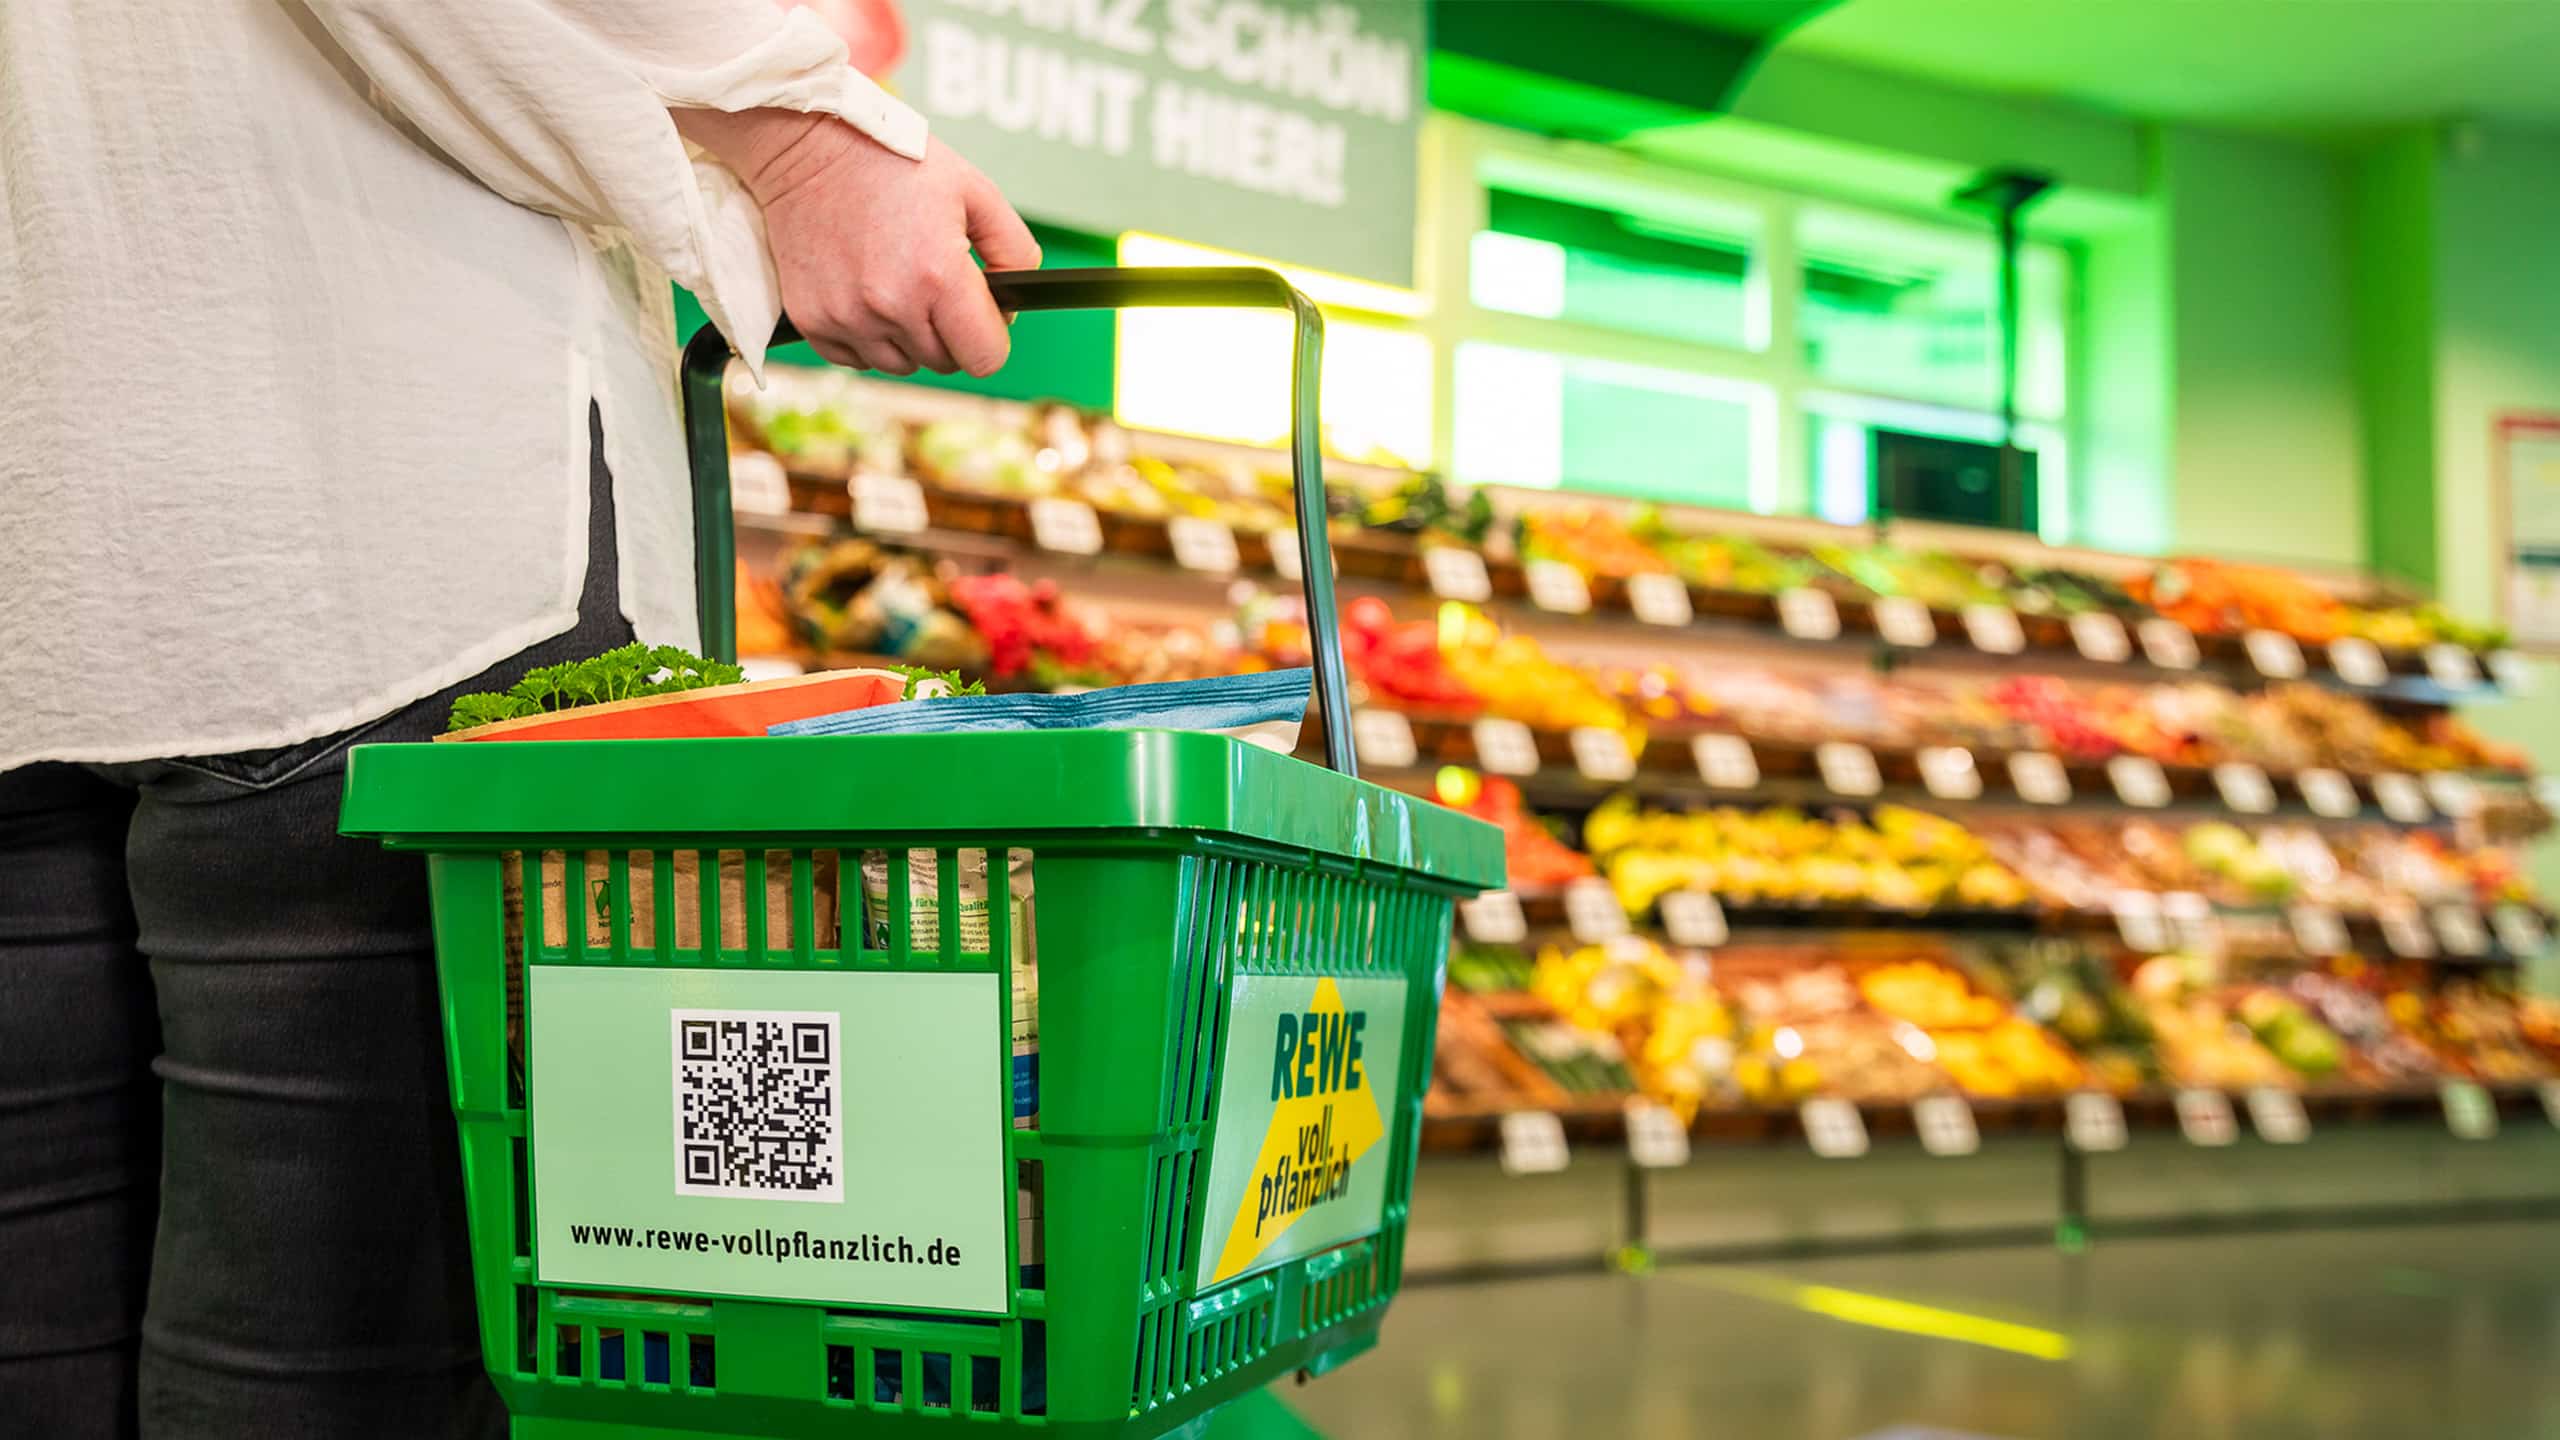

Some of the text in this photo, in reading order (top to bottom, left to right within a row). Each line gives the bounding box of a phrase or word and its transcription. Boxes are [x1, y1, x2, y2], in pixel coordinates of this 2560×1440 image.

[1164, 0, 1409, 121] SCHÖN
[926, 23, 1143, 154] BUNT
[1152, 81, 1346, 207] HIER!
[1271, 1012, 1366, 1102] REWE
[1298, 1104, 1333, 1166] voll
[1256, 1143, 1350, 1238] pflanzlich
[572, 1224, 961, 1266] www.rewe-vollpflanzlich.de
